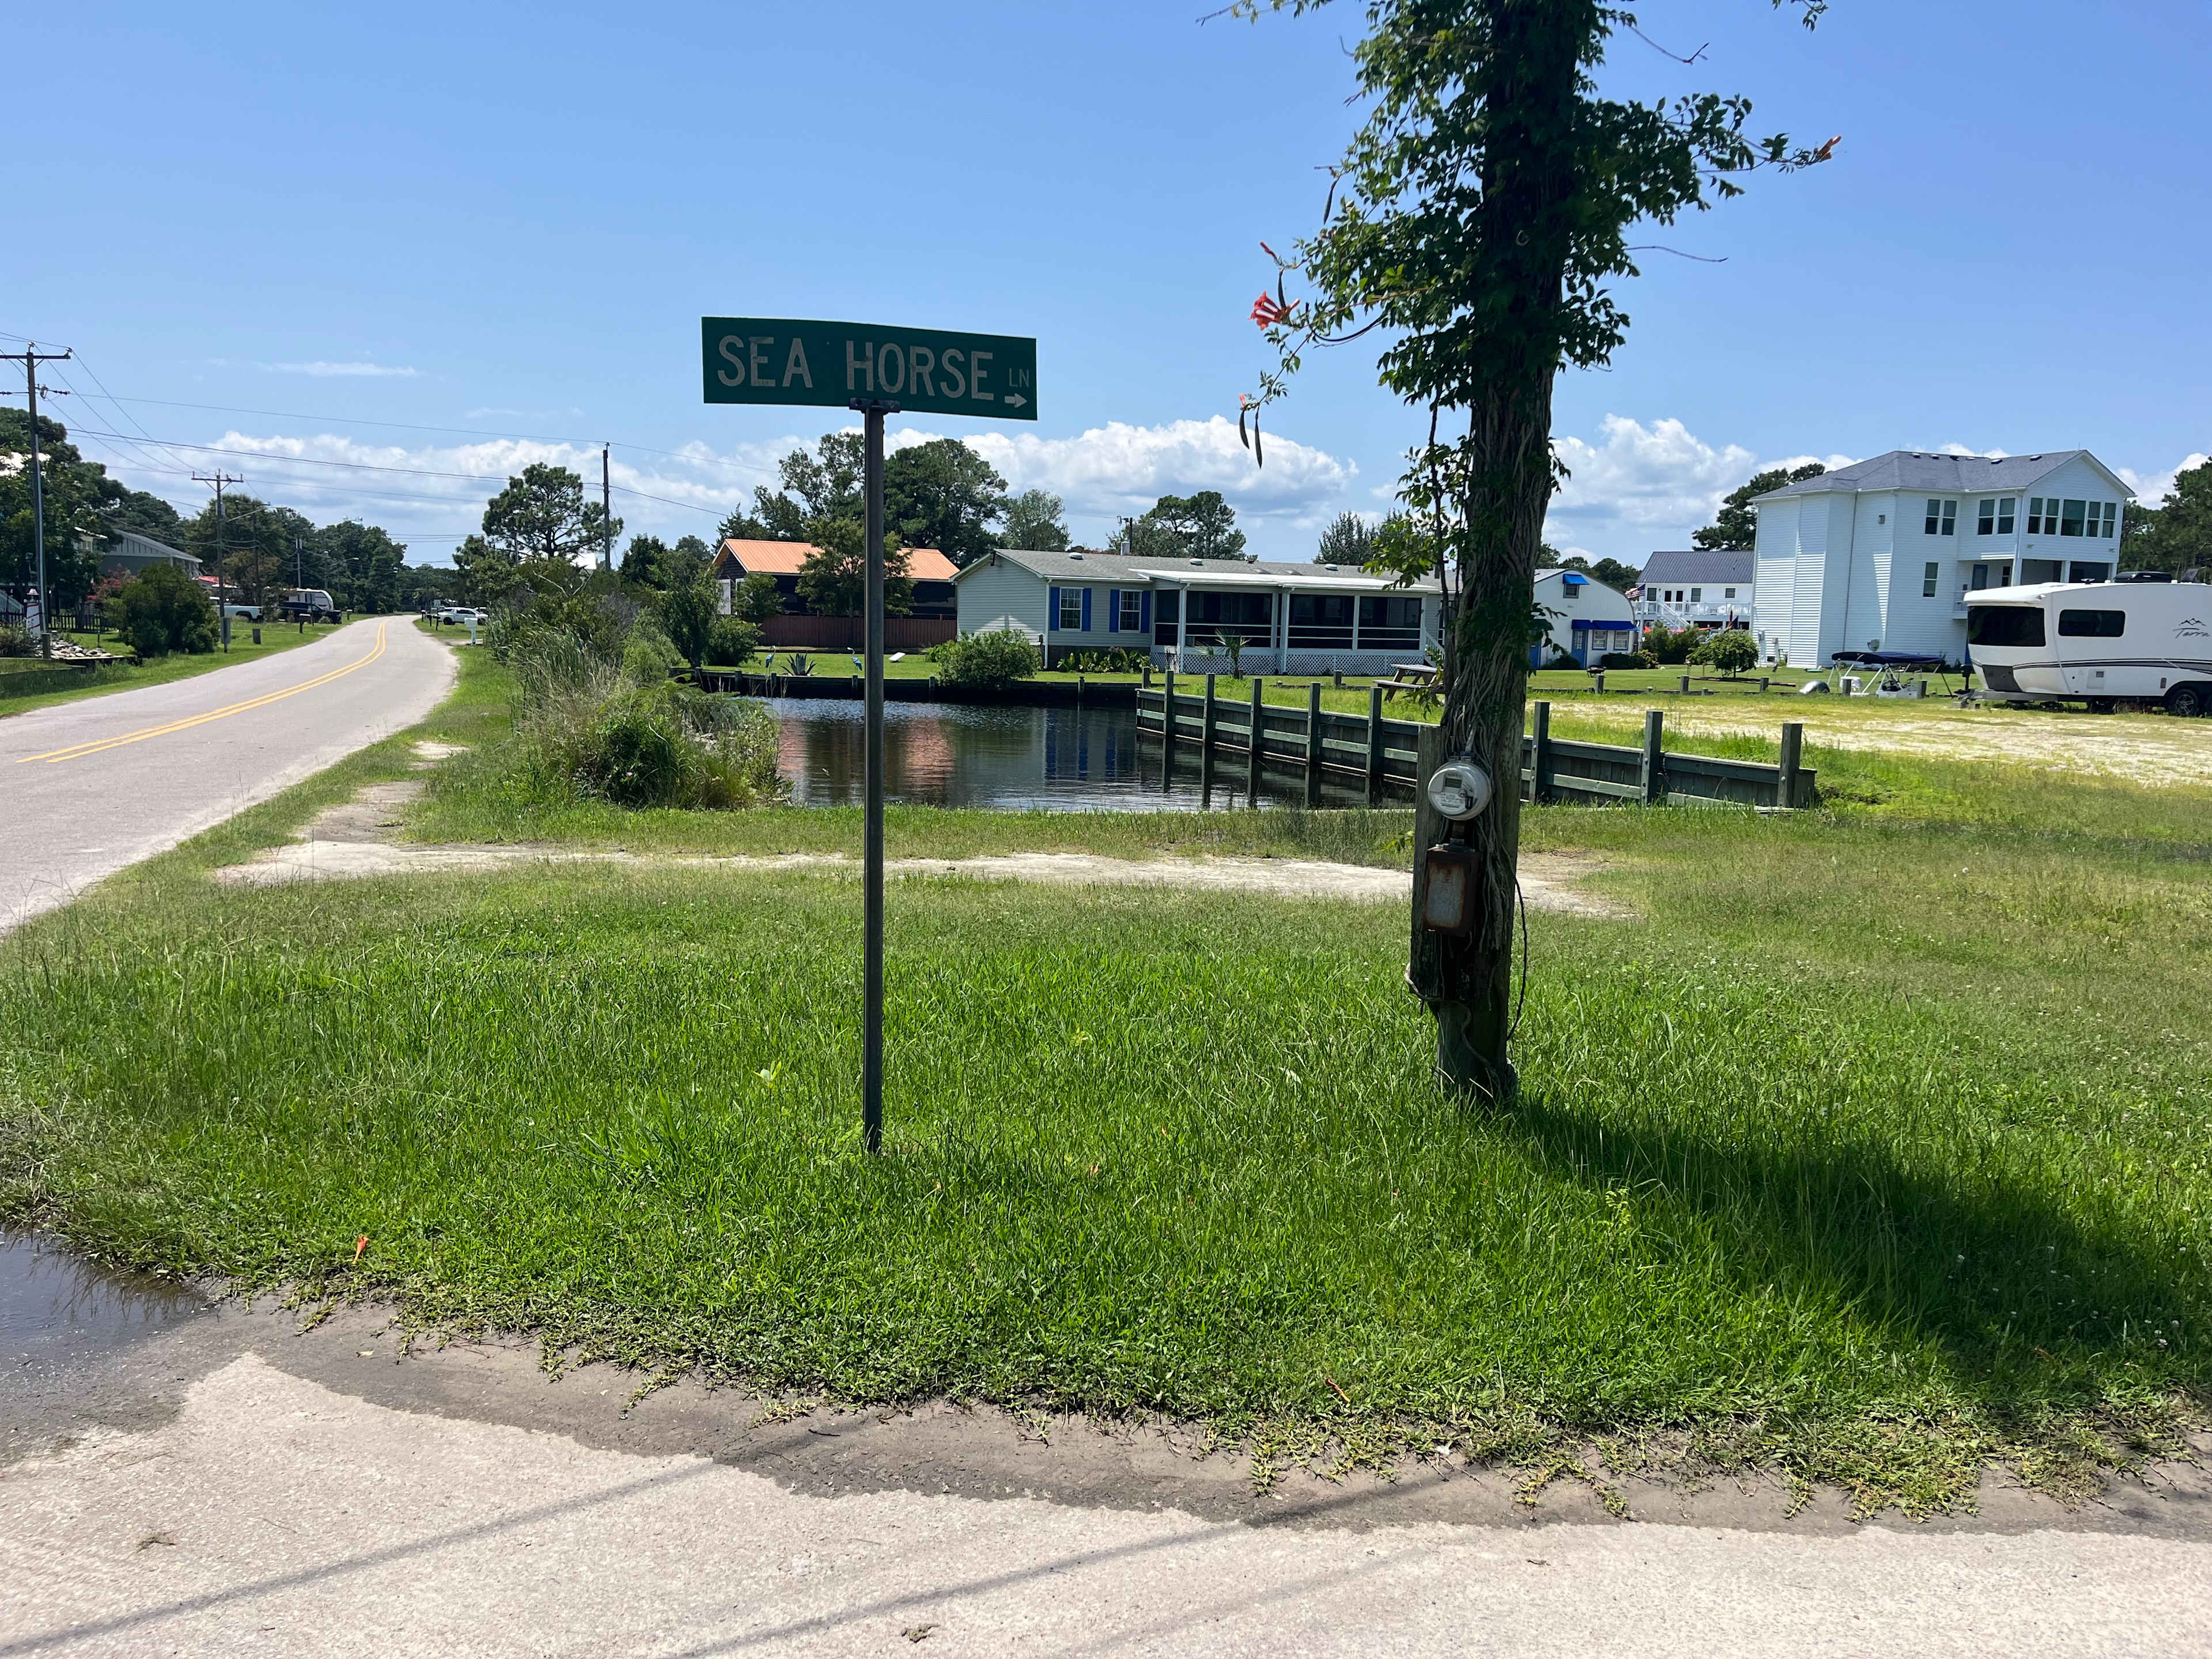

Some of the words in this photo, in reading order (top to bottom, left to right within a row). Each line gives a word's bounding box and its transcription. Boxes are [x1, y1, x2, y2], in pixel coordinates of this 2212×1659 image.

[717, 335, 813, 388] SEA
[845, 340, 994, 400] HORSE
[1009, 368, 1029, 388] LN
